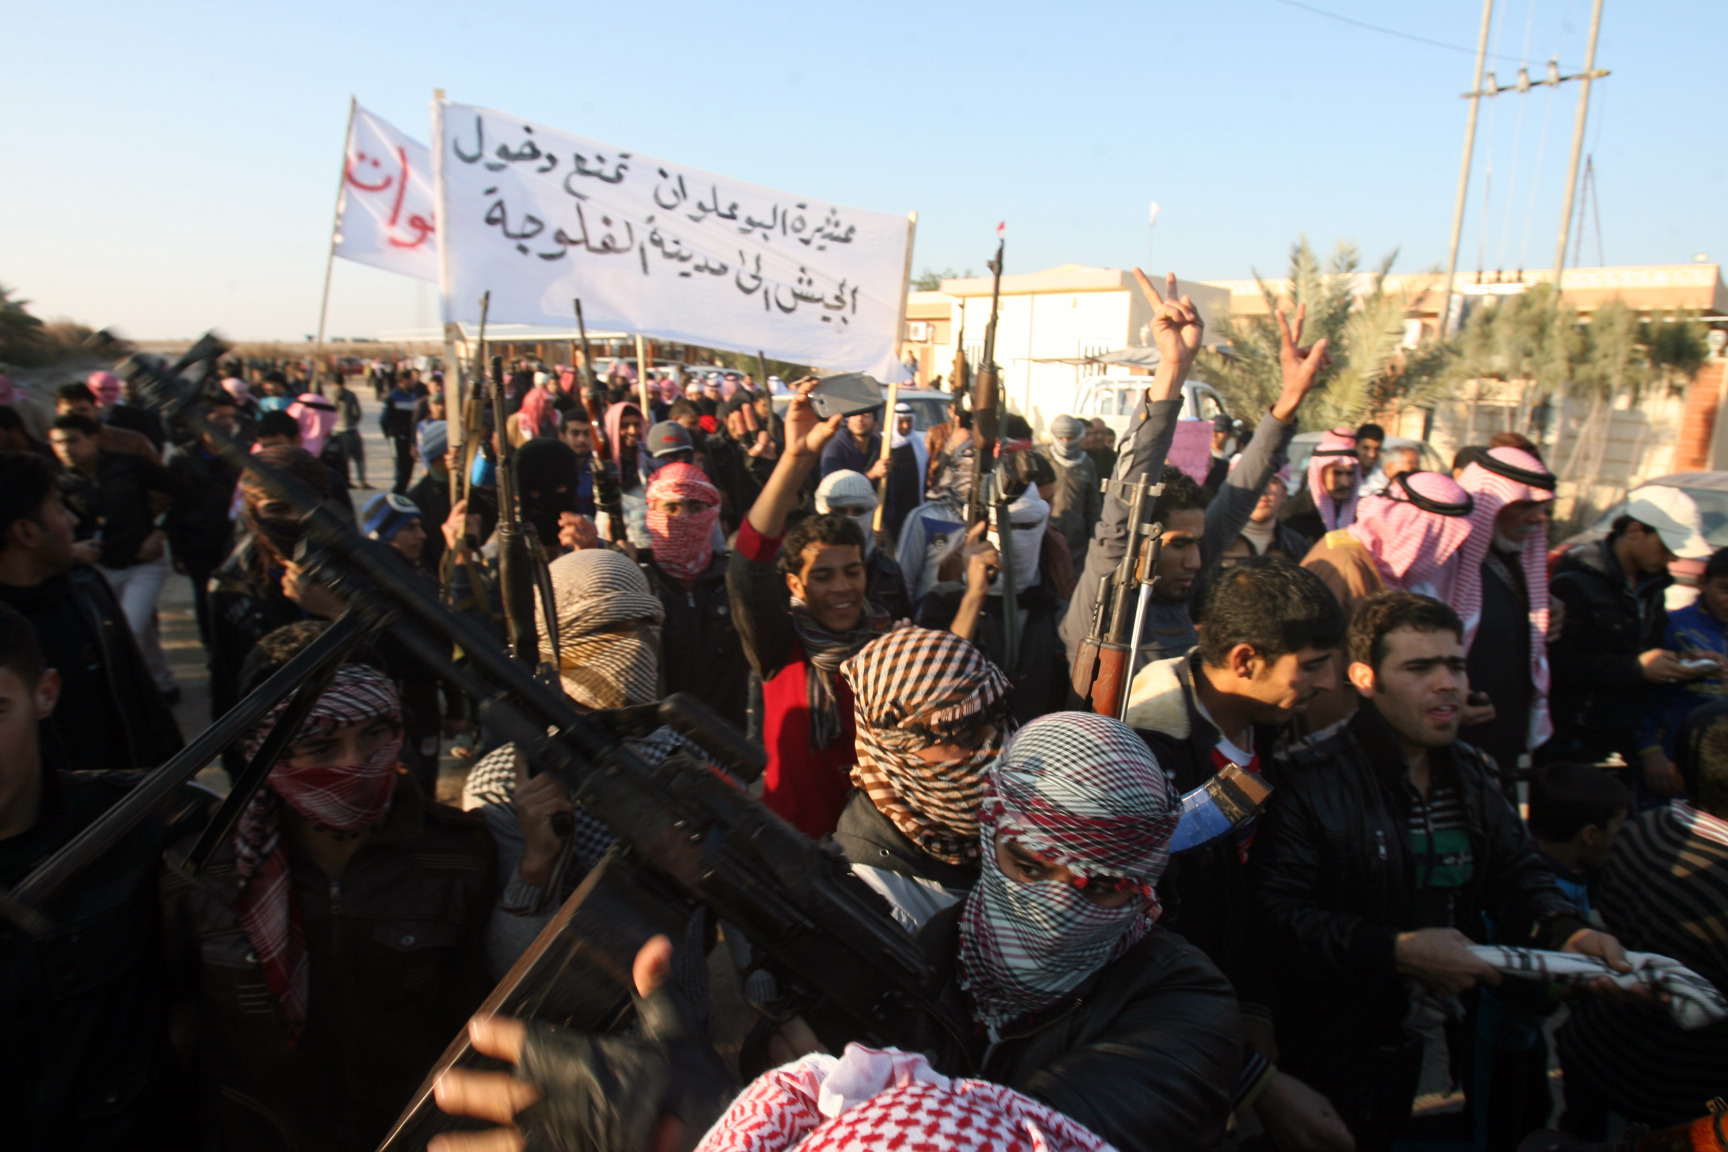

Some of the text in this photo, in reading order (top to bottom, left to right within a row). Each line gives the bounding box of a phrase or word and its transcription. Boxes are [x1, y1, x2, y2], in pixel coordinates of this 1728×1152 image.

[453, 114, 559, 172] دخول
[562, 152, 633, 201] تمنع
[483, 185, 650, 277] الفلوجة
[645, 213, 729, 278] مدينة
[790, 202, 857, 251] عشيرة
[774, 265, 859, 325] الجيش
